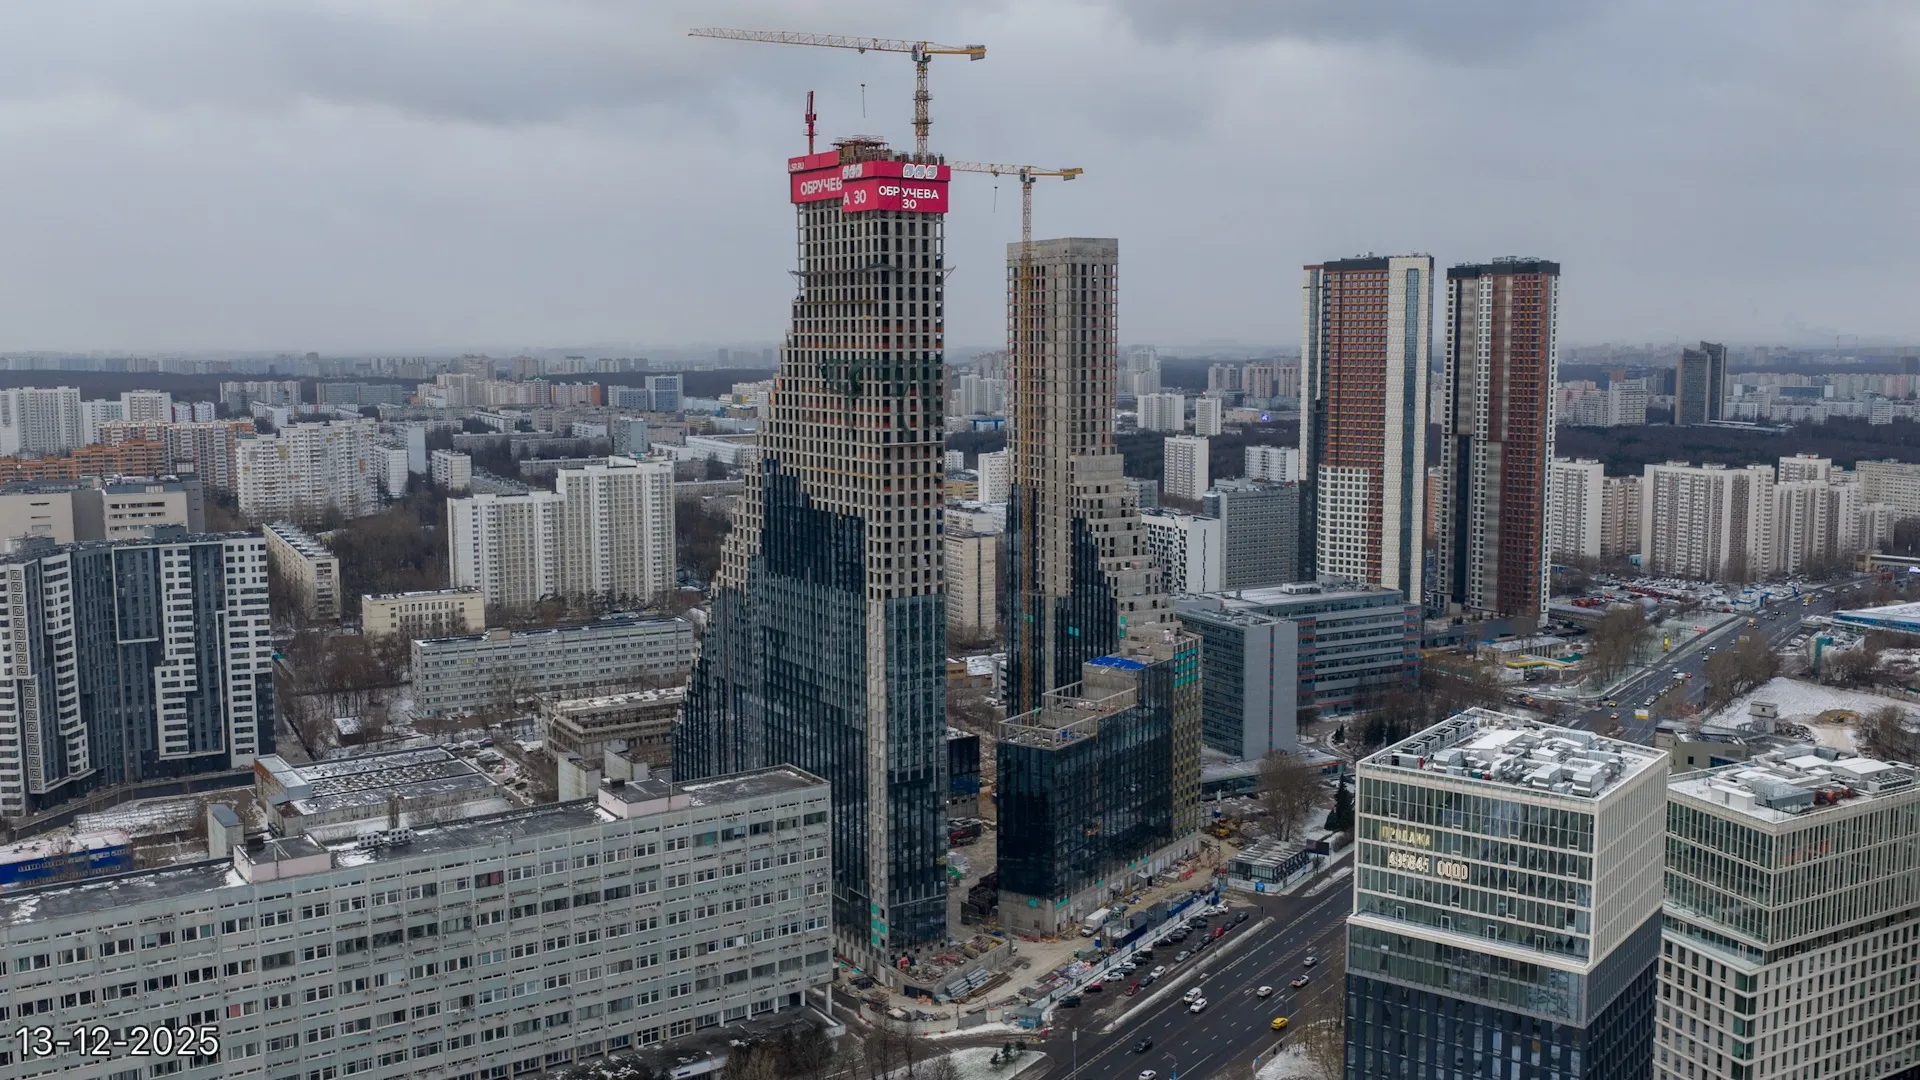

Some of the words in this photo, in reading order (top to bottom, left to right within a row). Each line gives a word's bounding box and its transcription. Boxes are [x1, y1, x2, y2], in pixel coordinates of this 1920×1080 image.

[854, 189, 867, 204] 30
[878, 185, 939, 199] ОБРУЧЕВА
[902, 199, 917, 209] 30
[1437, 860, 1469, 880] 0000
